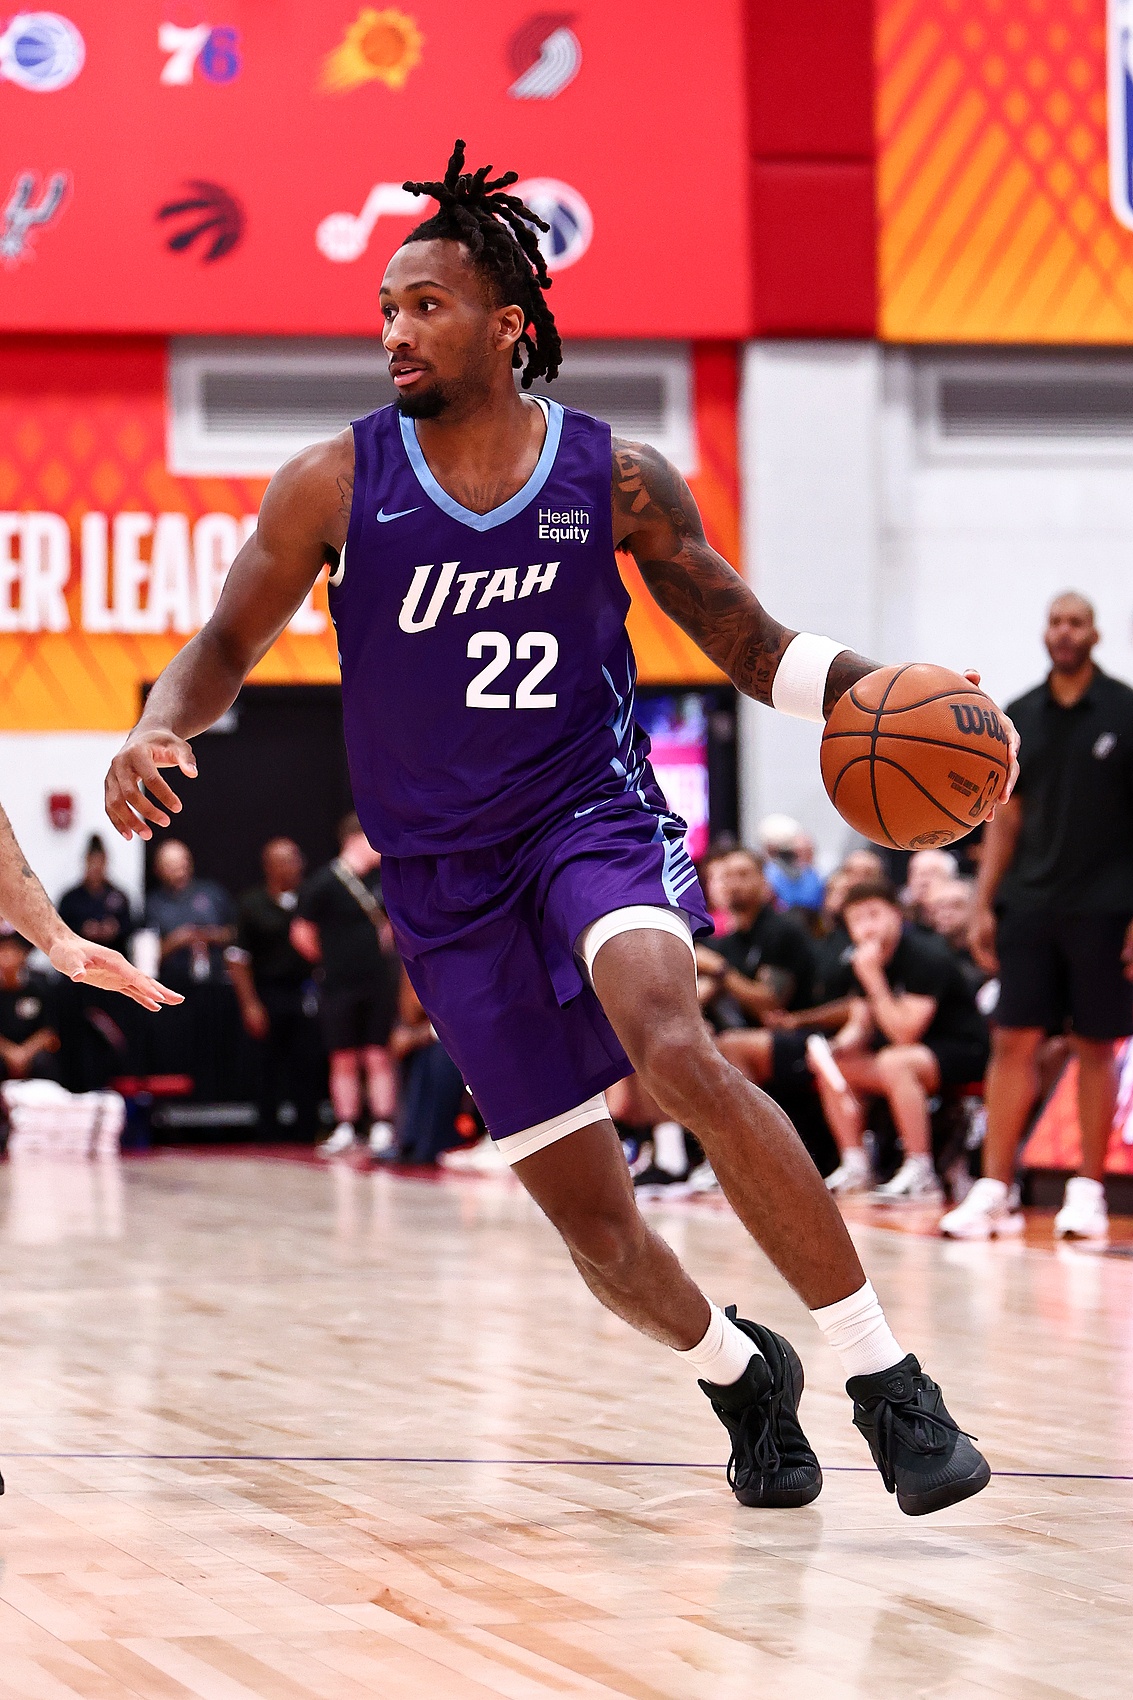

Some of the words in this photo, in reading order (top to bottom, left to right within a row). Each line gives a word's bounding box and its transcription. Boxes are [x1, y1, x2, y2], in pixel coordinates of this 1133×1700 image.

[158, 20, 238, 85] 76
[538, 508, 590, 525] Health
[538, 524, 590, 544] Equity
[80, 511, 328, 635] LEAG
[398, 561, 561, 634] UTAH
[465, 630, 559, 709] 22
